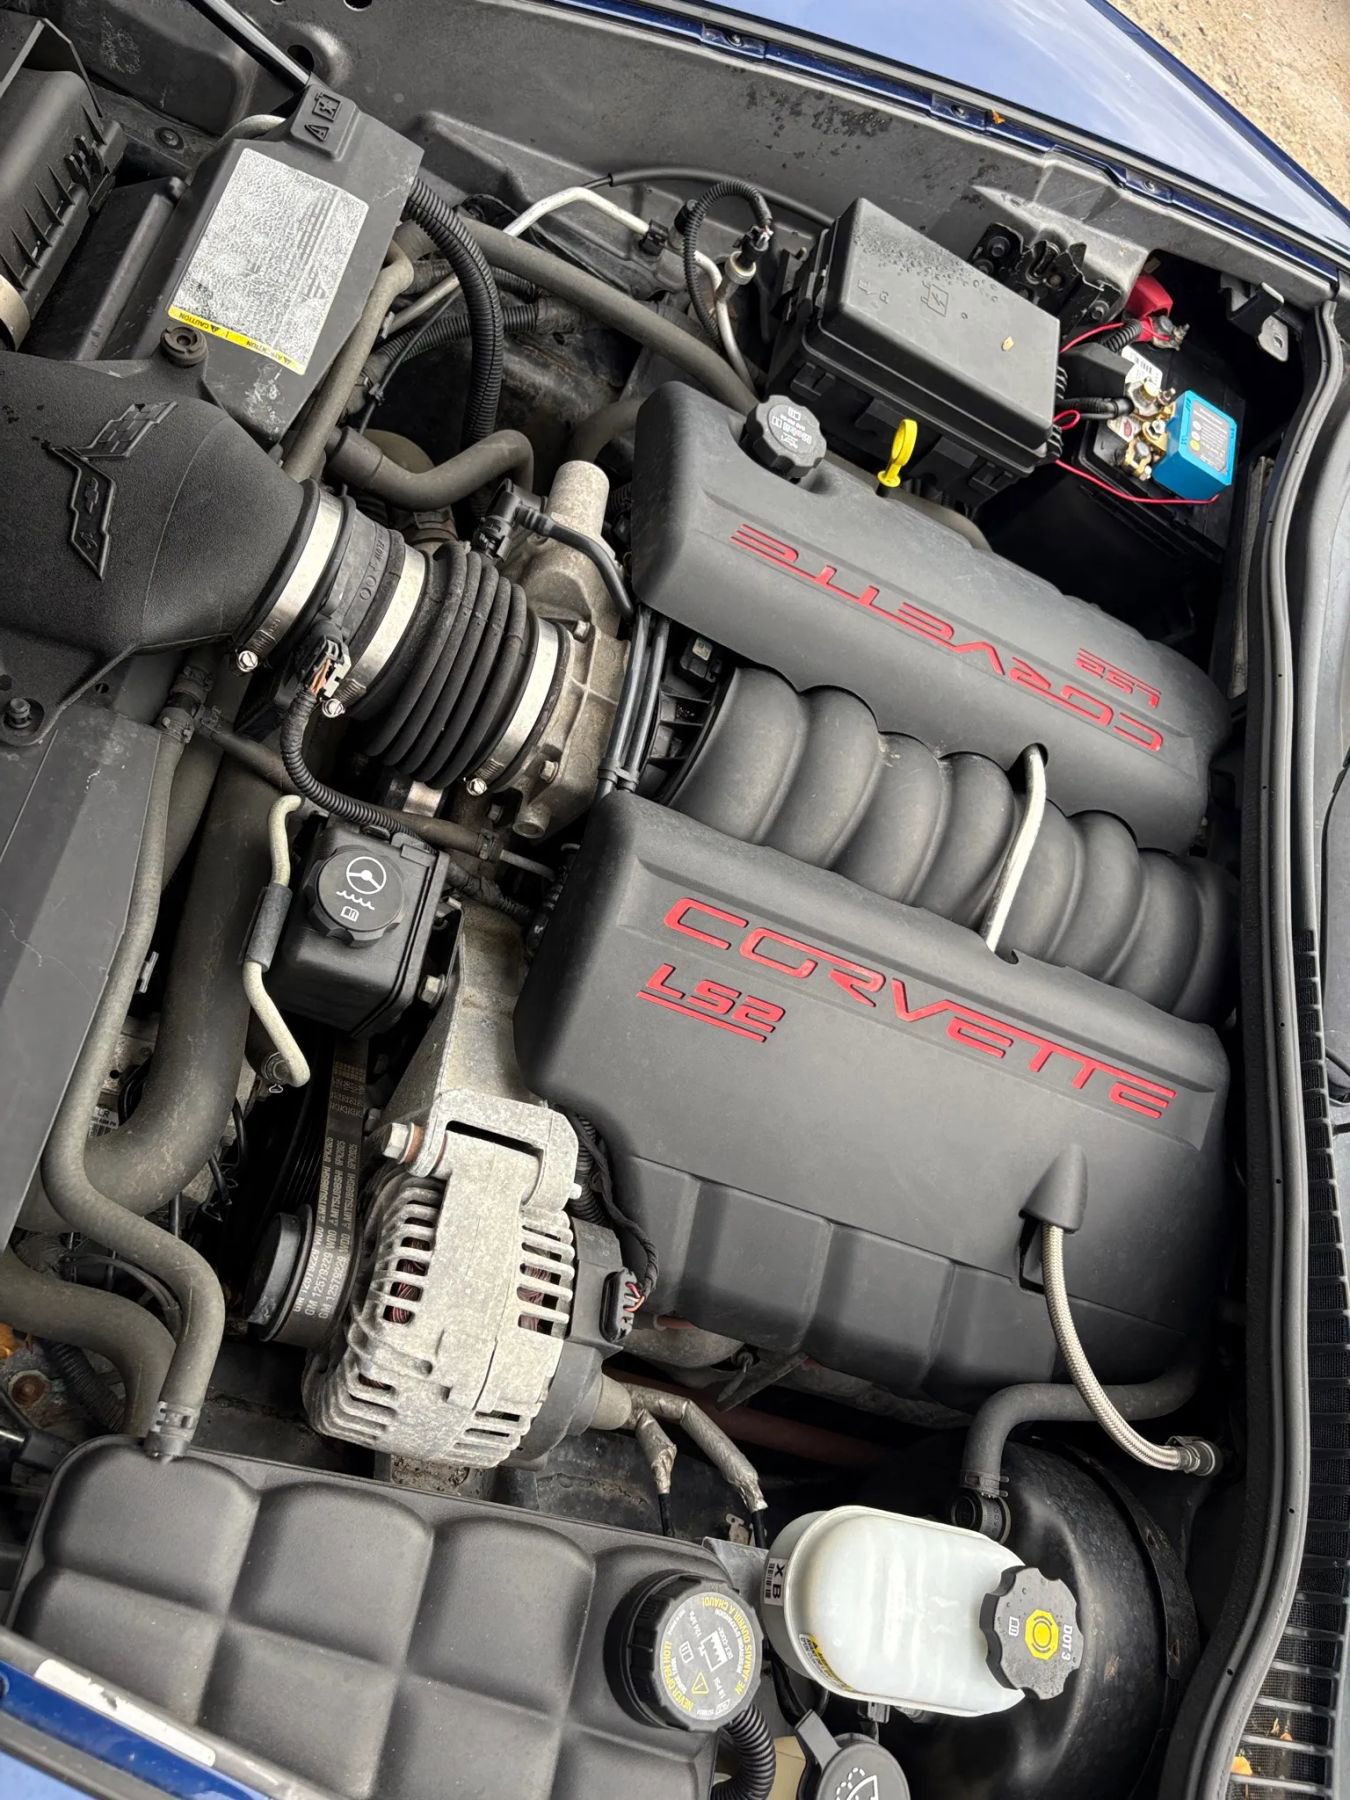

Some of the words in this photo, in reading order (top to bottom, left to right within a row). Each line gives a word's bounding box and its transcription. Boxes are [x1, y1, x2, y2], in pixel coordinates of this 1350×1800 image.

[179, 313, 209, 329] CAUTION
[729, 523, 1164, 752] CORVETTE
[1075, 651, 1162, 708] LS2
[643, 963, 786, 1036] LS2
[664, 897, 1177, 1119] CORVETTE
[305, 1300, 319, 1315] GM
[312, 1251, 333, 1297] 12579229
[318, 1304, 332, 1319] GM
[325, 1254, 346, 1301] 12579229
[775, 1564, 784, 1576] X
[773, 1584, 781, 1598] B
[1062, 1625, 1072, 1651] DOT
[740, 1645, 752, 1681] JAMAIS
[1061, 1652, 1071, 1661] 3
[664, 1664, 678, 1689] OPEN
[671, 1688, 694, 1712] NEVER
